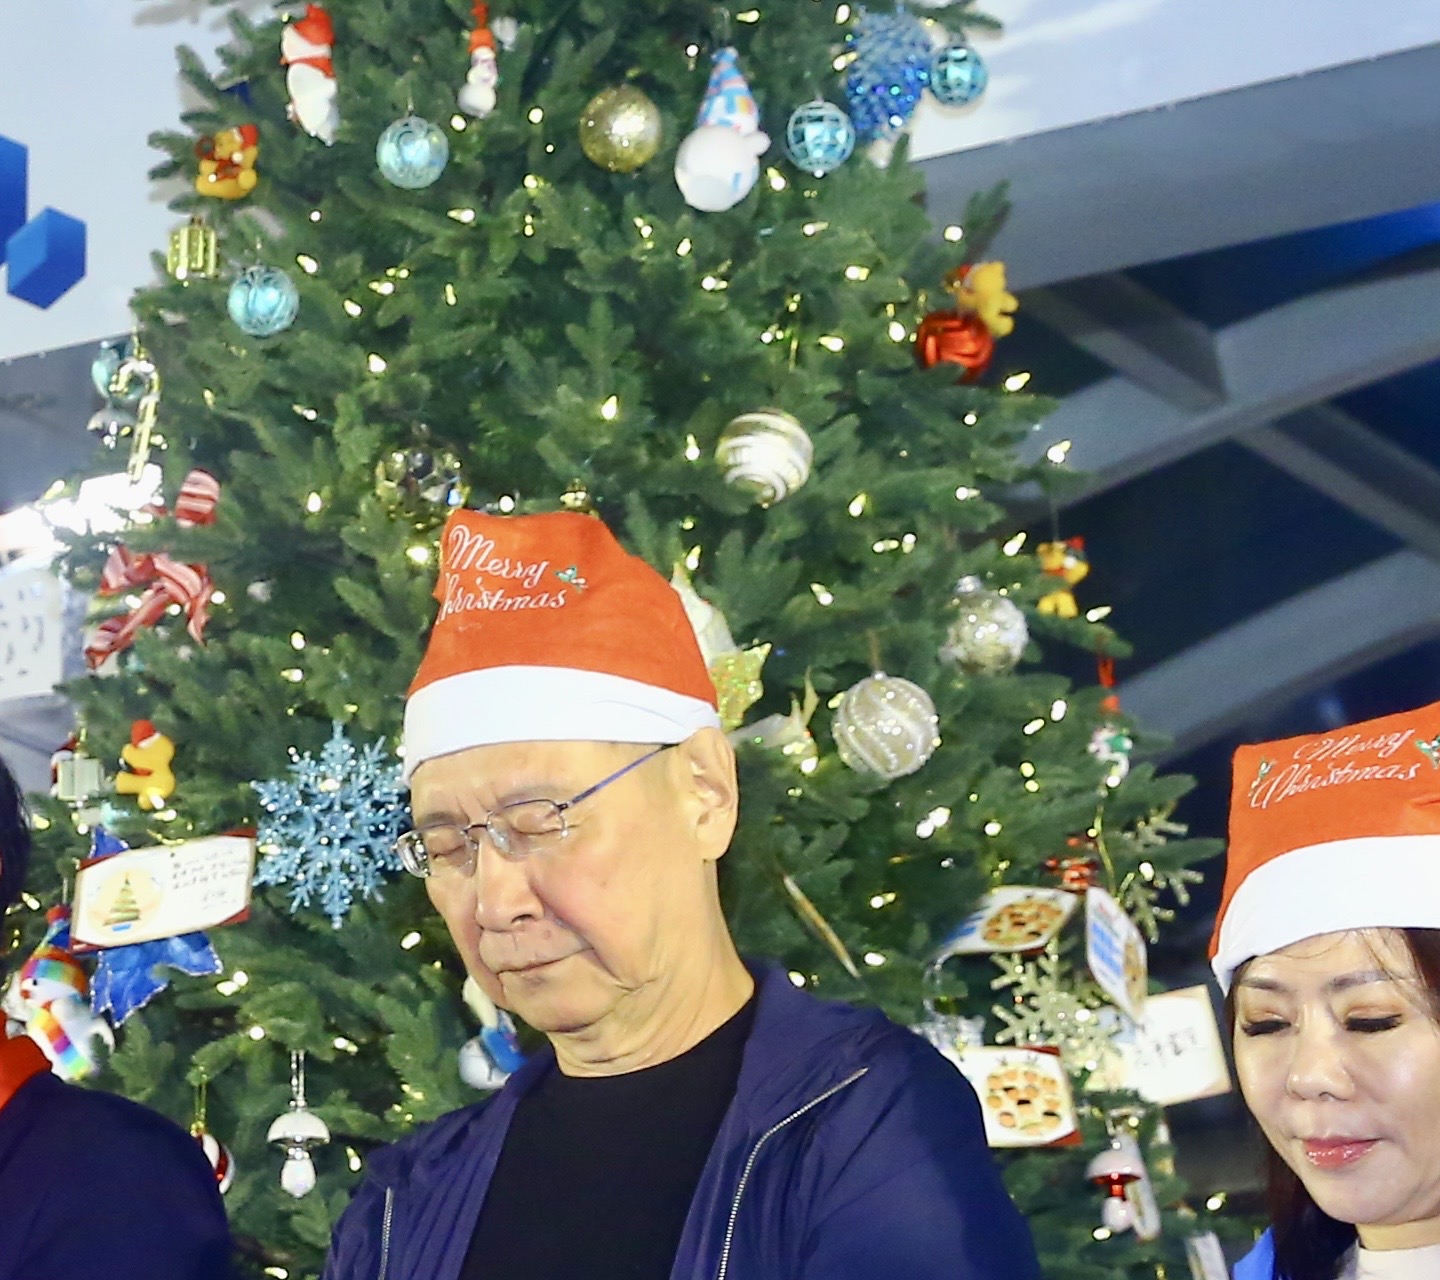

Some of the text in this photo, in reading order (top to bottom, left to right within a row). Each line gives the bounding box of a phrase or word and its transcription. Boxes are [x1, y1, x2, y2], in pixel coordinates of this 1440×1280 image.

[447, 524, 549, 588] Merry
[436, 572, 567, 625] hristmas
[1292, 728, 1416, 761] Merry
[1250, 762, 1422, 809] Christmas
